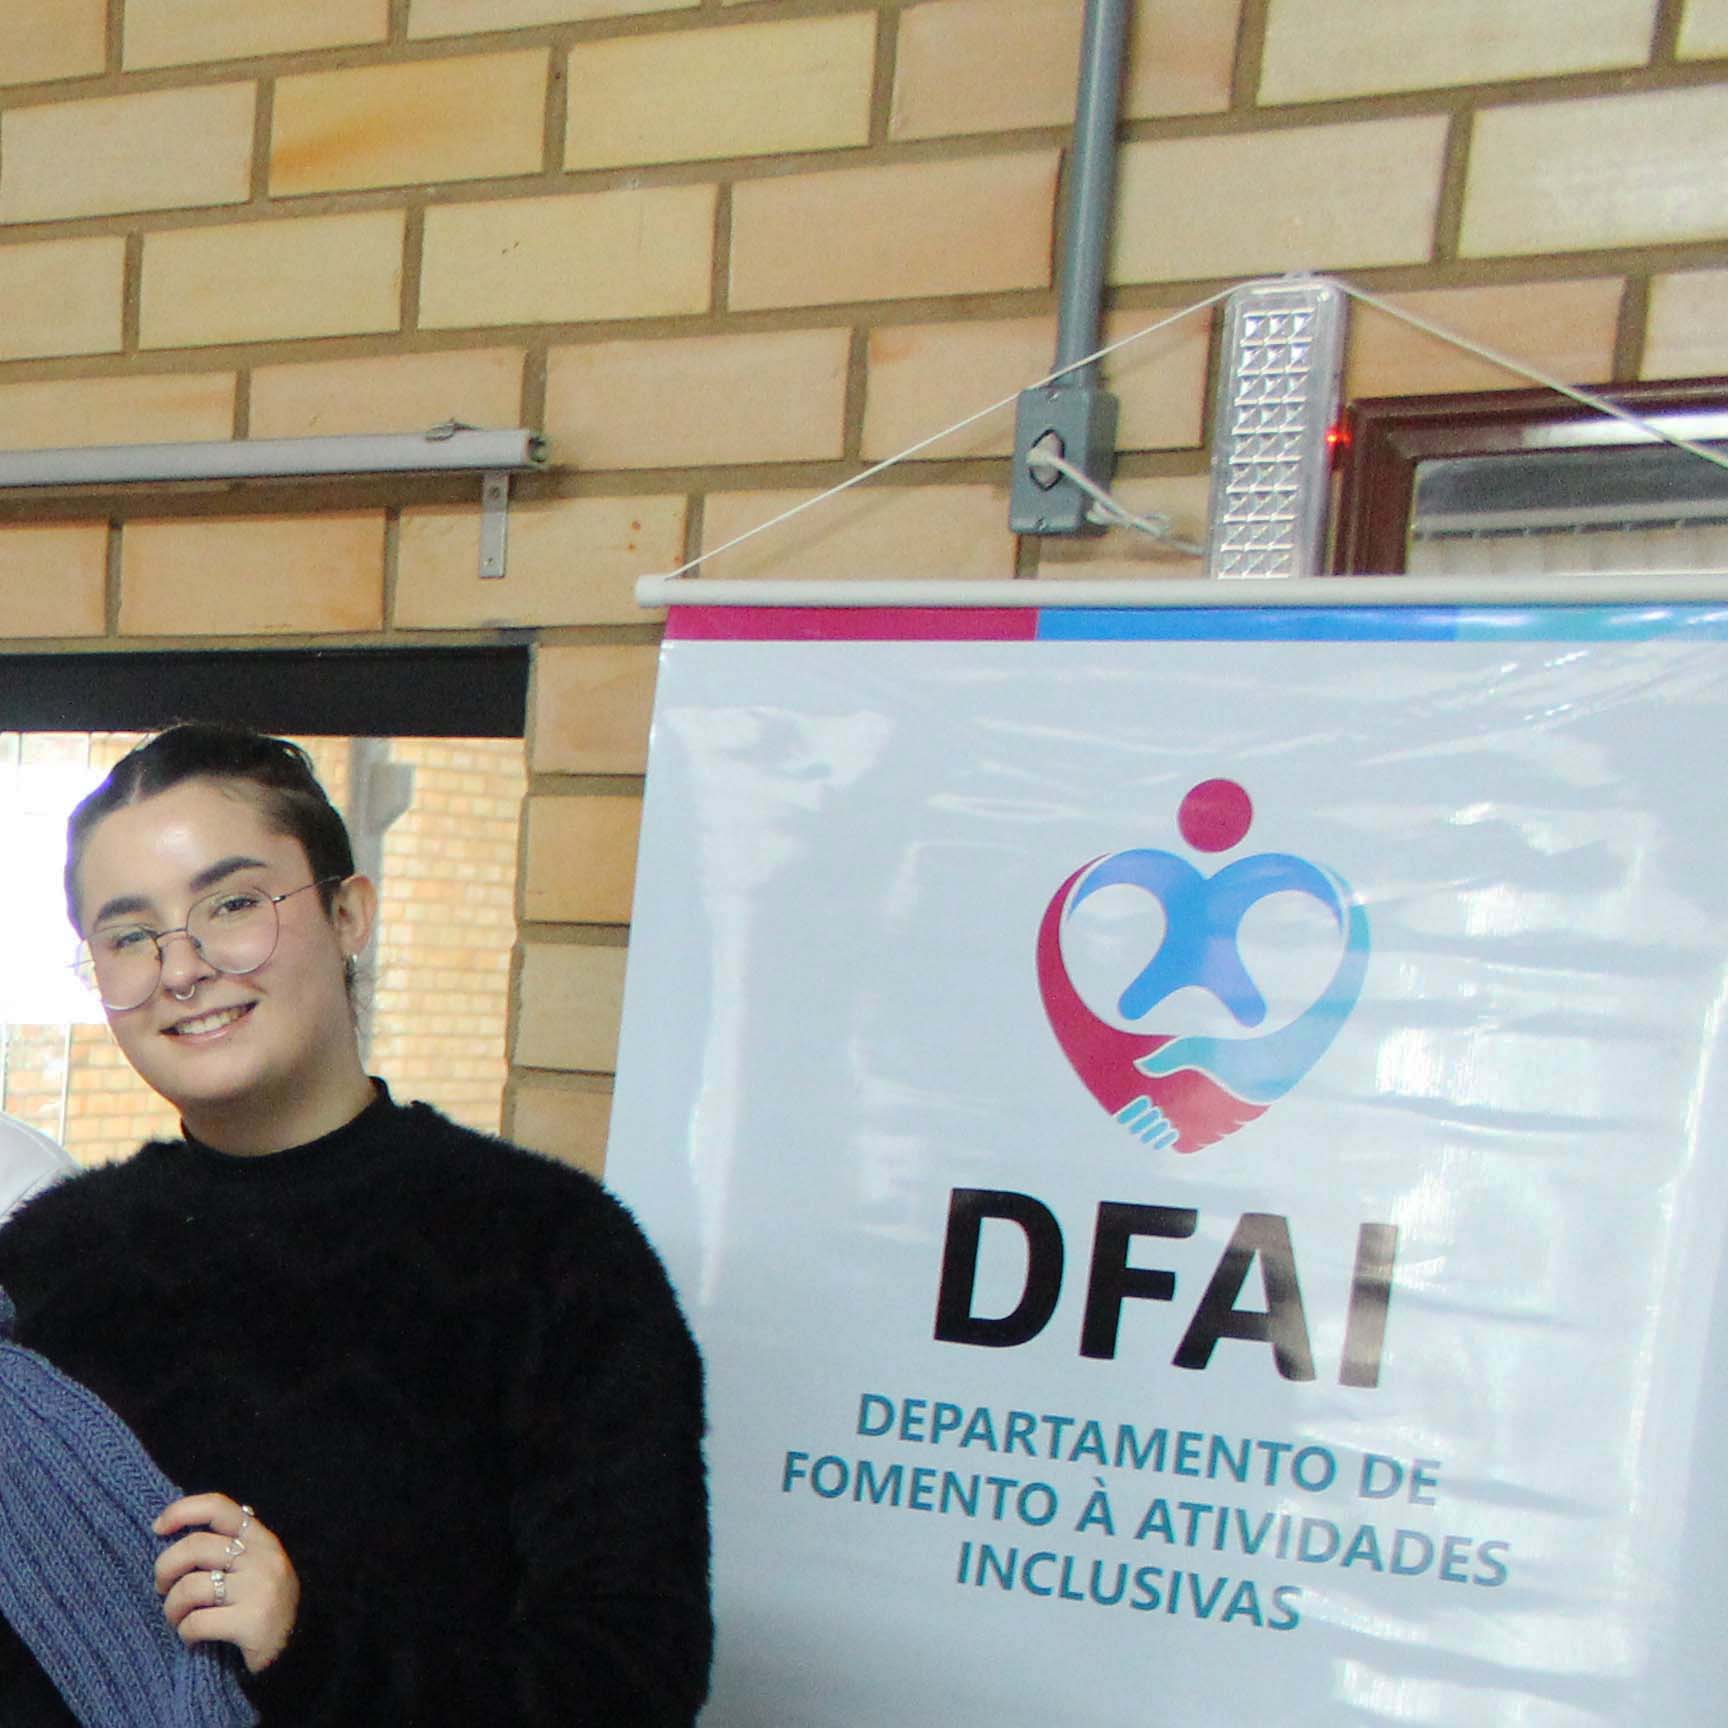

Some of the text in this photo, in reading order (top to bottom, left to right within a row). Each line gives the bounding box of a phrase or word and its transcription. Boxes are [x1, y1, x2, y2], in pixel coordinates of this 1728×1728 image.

[934, 1187, 1399, 1389] DFAI
[856, 1393, 1441, 1506] DEPARTAMENTO DE
[781, 1451, 1510, 1588] FOMENTO À ATIVIDADES
[957, 1541, 1304, 1632] INCLUSIVAS
